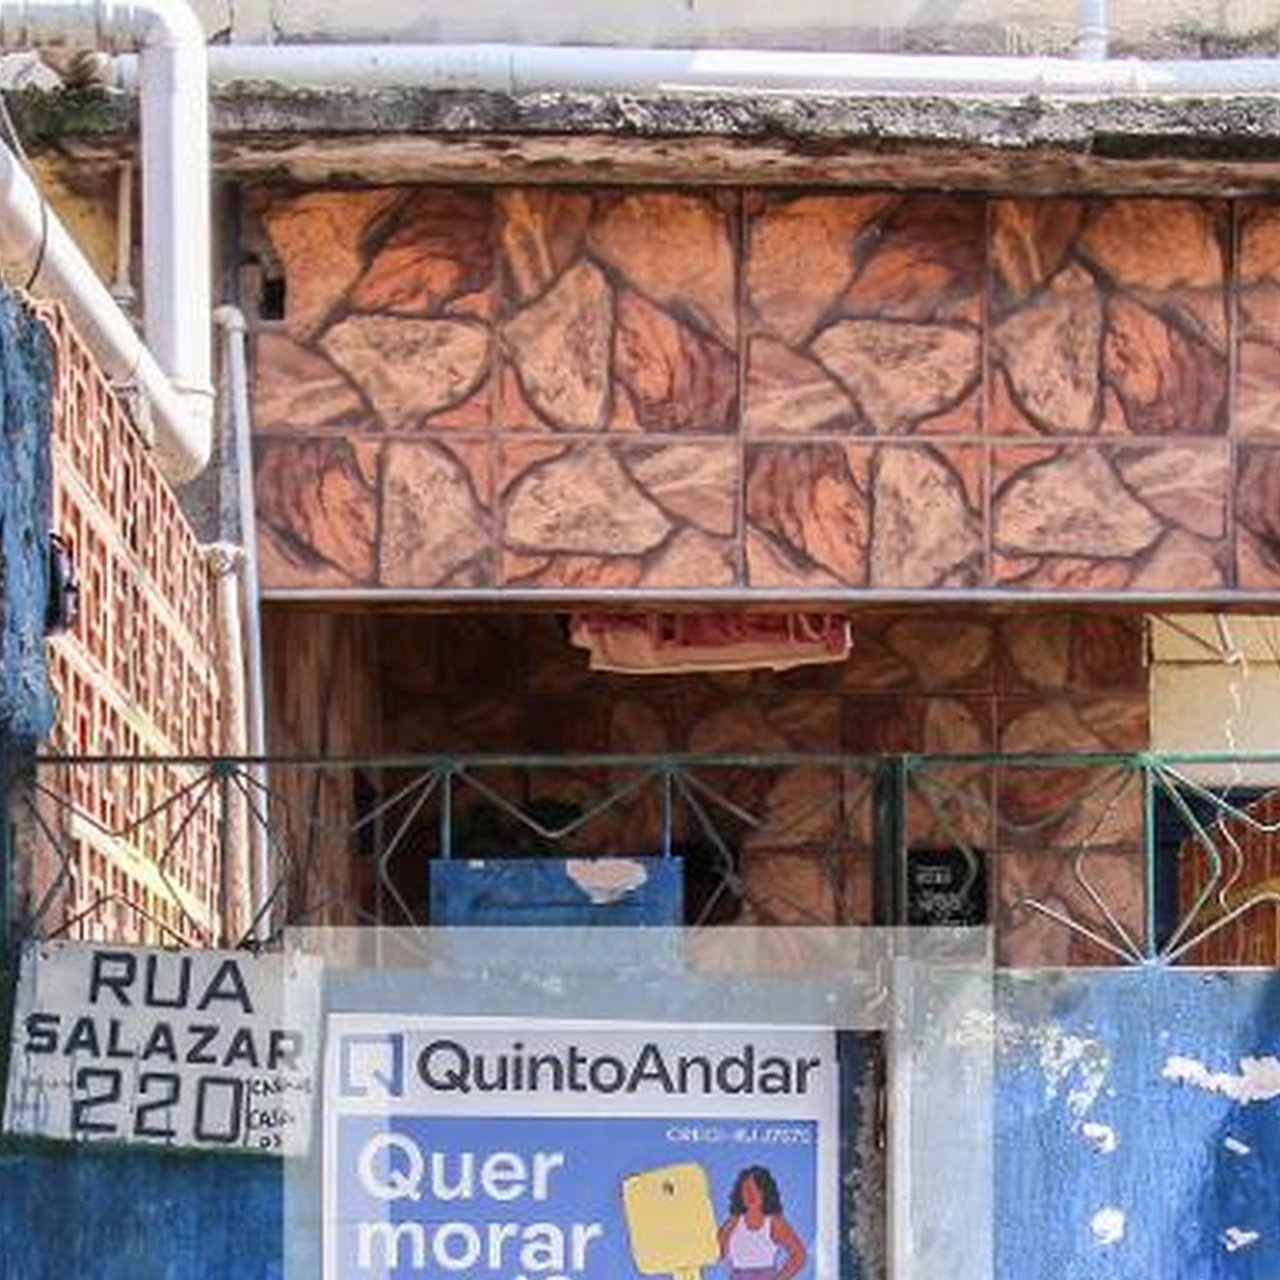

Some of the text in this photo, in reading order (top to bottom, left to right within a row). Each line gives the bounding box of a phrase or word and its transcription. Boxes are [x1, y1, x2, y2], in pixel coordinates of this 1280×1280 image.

[89, 951, 254, 1013] RUA
[24, 1013, 303, 1070] SALAZAR
[418, 1038, 821, 1096] QuintoAndar
[74, 1067, 243, 1143] 220
[356, 1132, 565, 1201] Quer
[356, 1218, 603, 1270] morar
